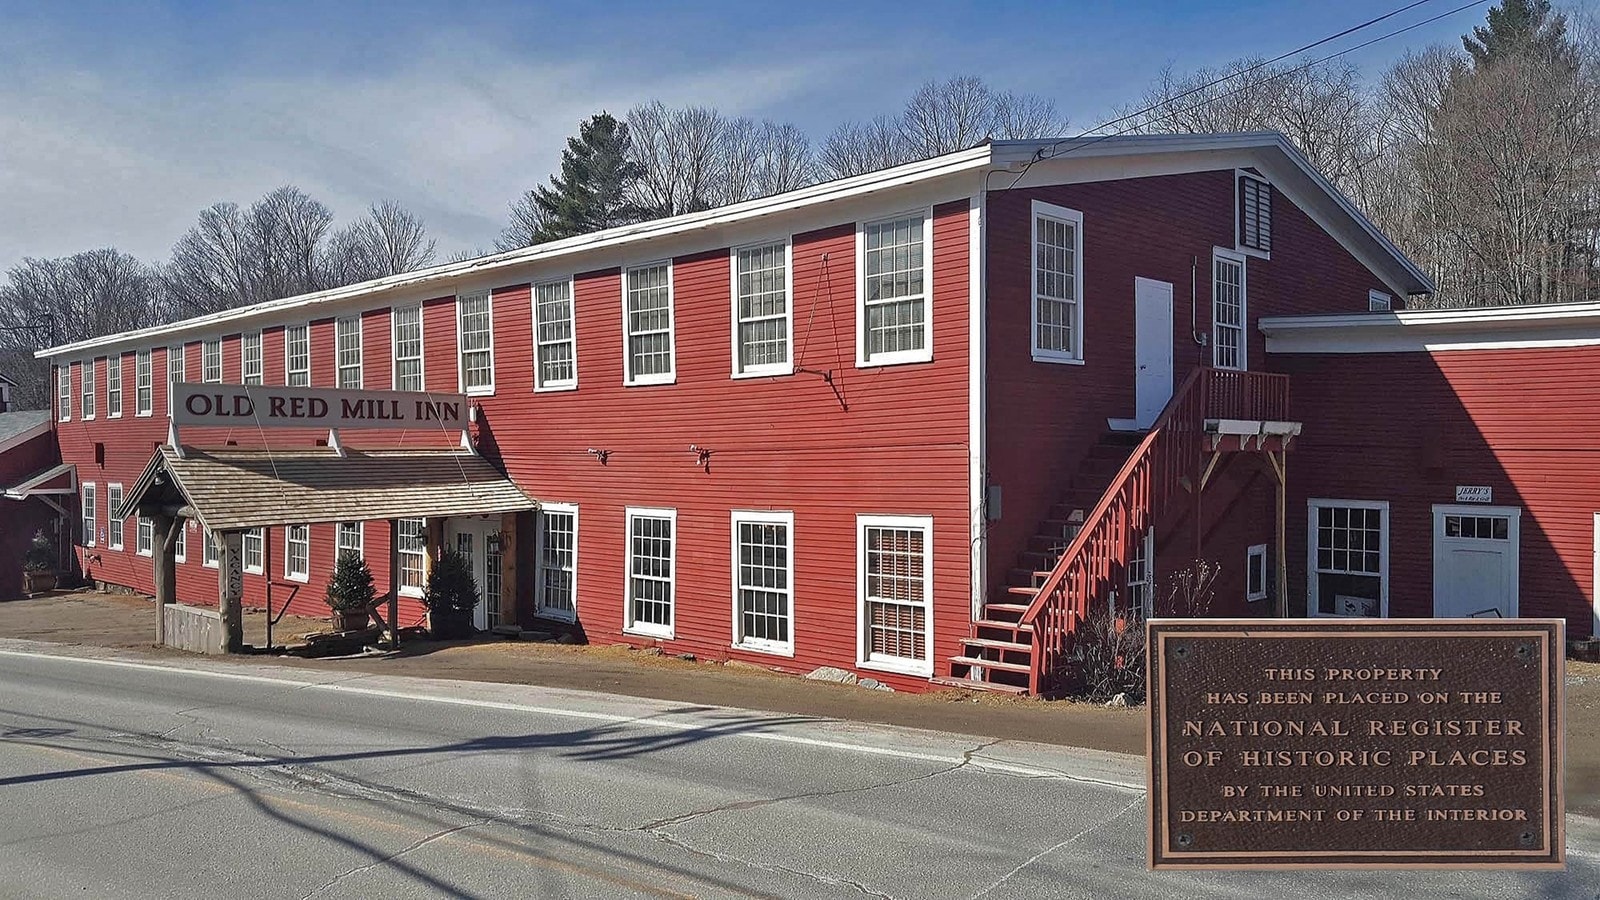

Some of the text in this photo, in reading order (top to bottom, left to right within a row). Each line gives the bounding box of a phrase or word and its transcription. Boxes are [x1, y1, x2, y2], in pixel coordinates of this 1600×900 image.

[186, 394, 459, 421] OLD RED MILL INN
[1458, 487, 1489, 495] JERRY'S
[230, 548, 240, 595] VACANCY
[1265, 668, 1443, 681] THIS PROPERTY
[1206, 691, 1503, 704] HAS BEEN PLACED ON THE
[1183, 720, 1526, 737] NATIONAL REGISTER
[1183, 750, 1528, 767] OF HISTORIC PLACES
[1223, 784, 1485, 798] BY THE UNITED STATES
[1180, 809, 1528, 823] DEPARTMENT OF THE INTERIOR
